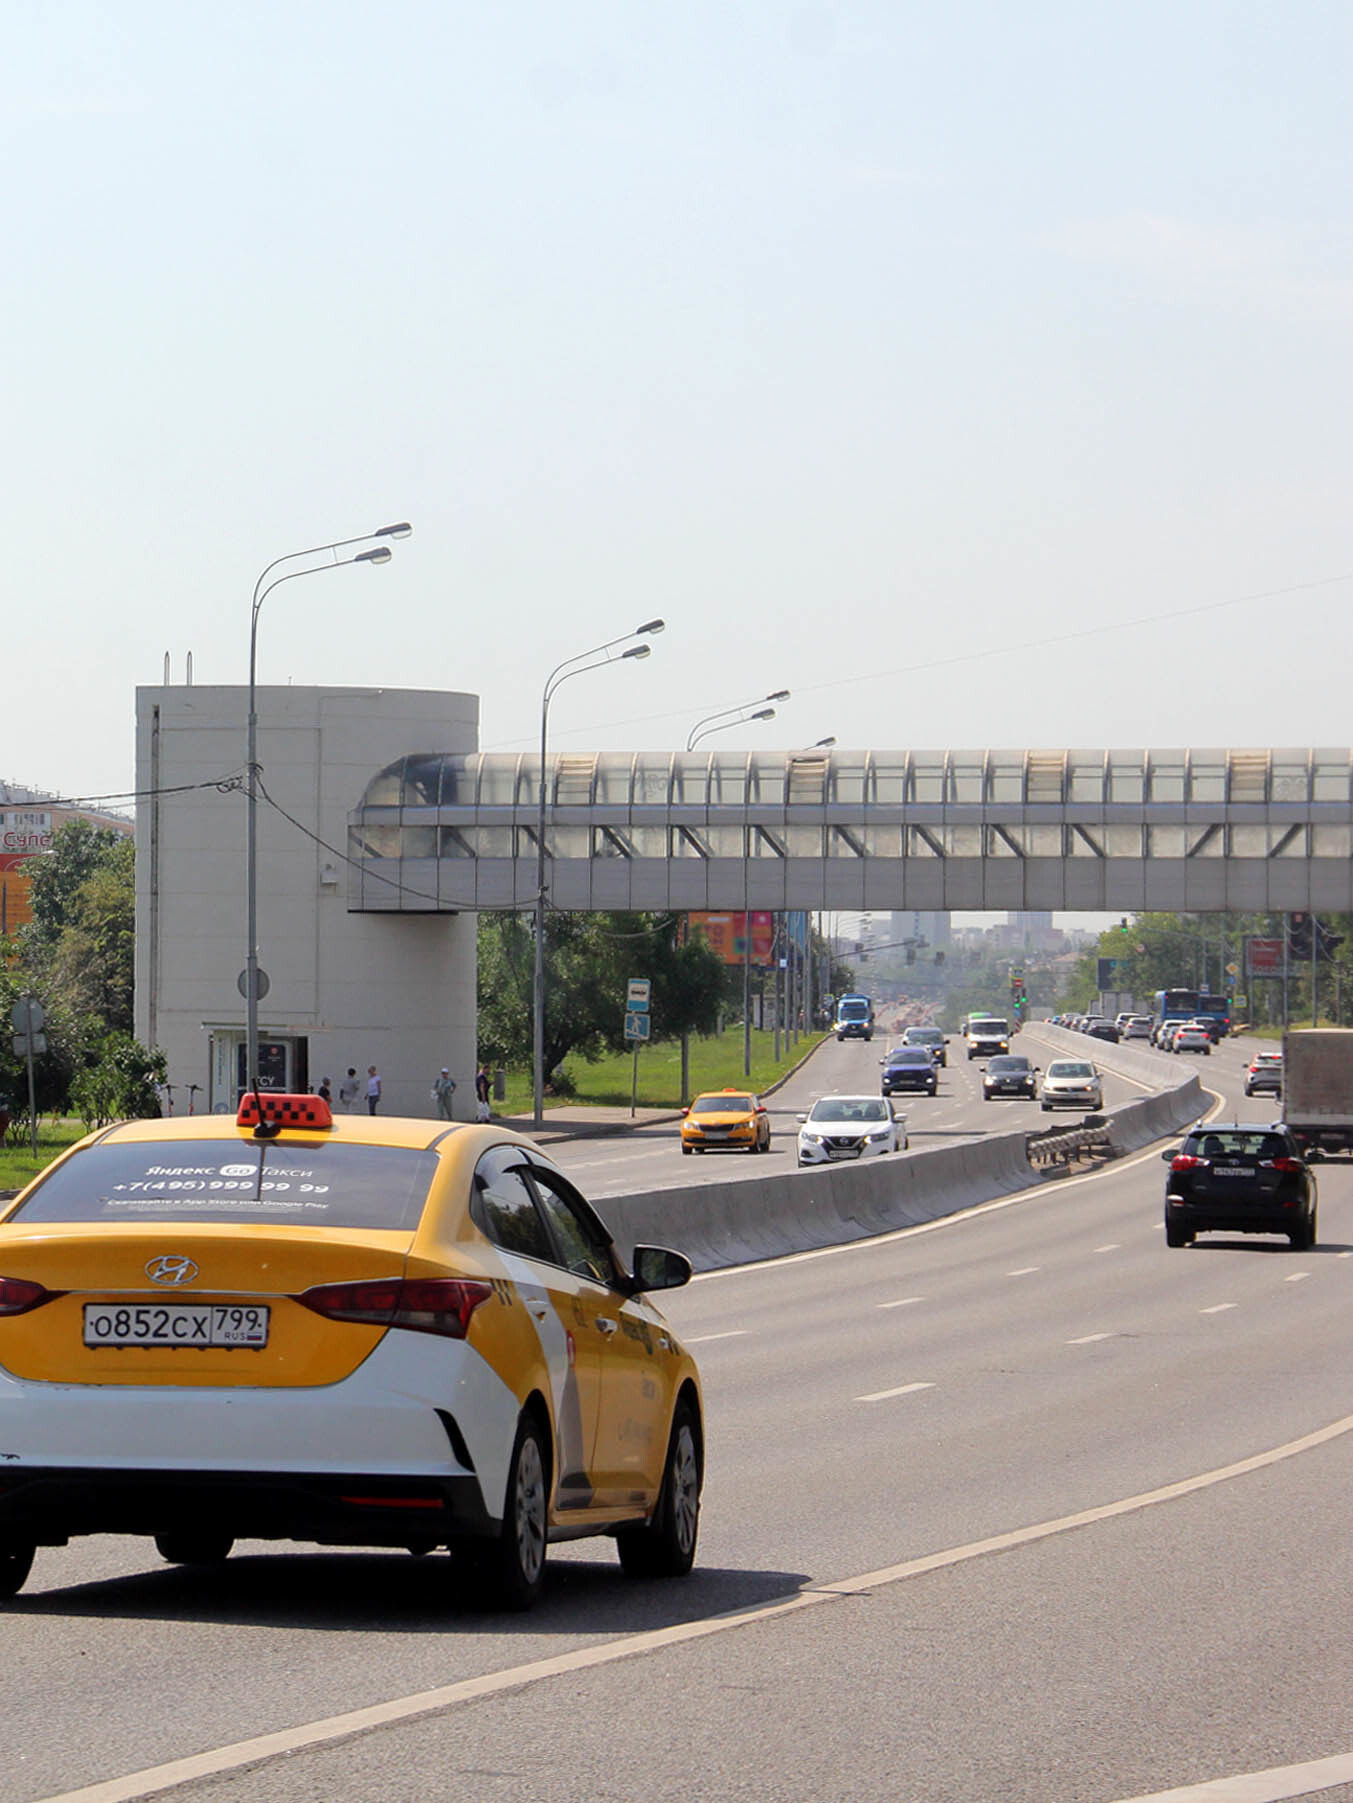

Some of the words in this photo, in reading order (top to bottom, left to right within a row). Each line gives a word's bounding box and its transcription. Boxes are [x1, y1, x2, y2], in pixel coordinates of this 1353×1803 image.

[4, 832, 54, 847] Супе
[145, 1165, 216, 1177] Яндекс
[260, 1166, 314, 1177] Такси
[260, 1182, 290, 1192] 99
[299, 1183, 329, 1193] 99
[215, 1309, 259, 1331] 799
[224, 1331, 246, 1341] RUS
